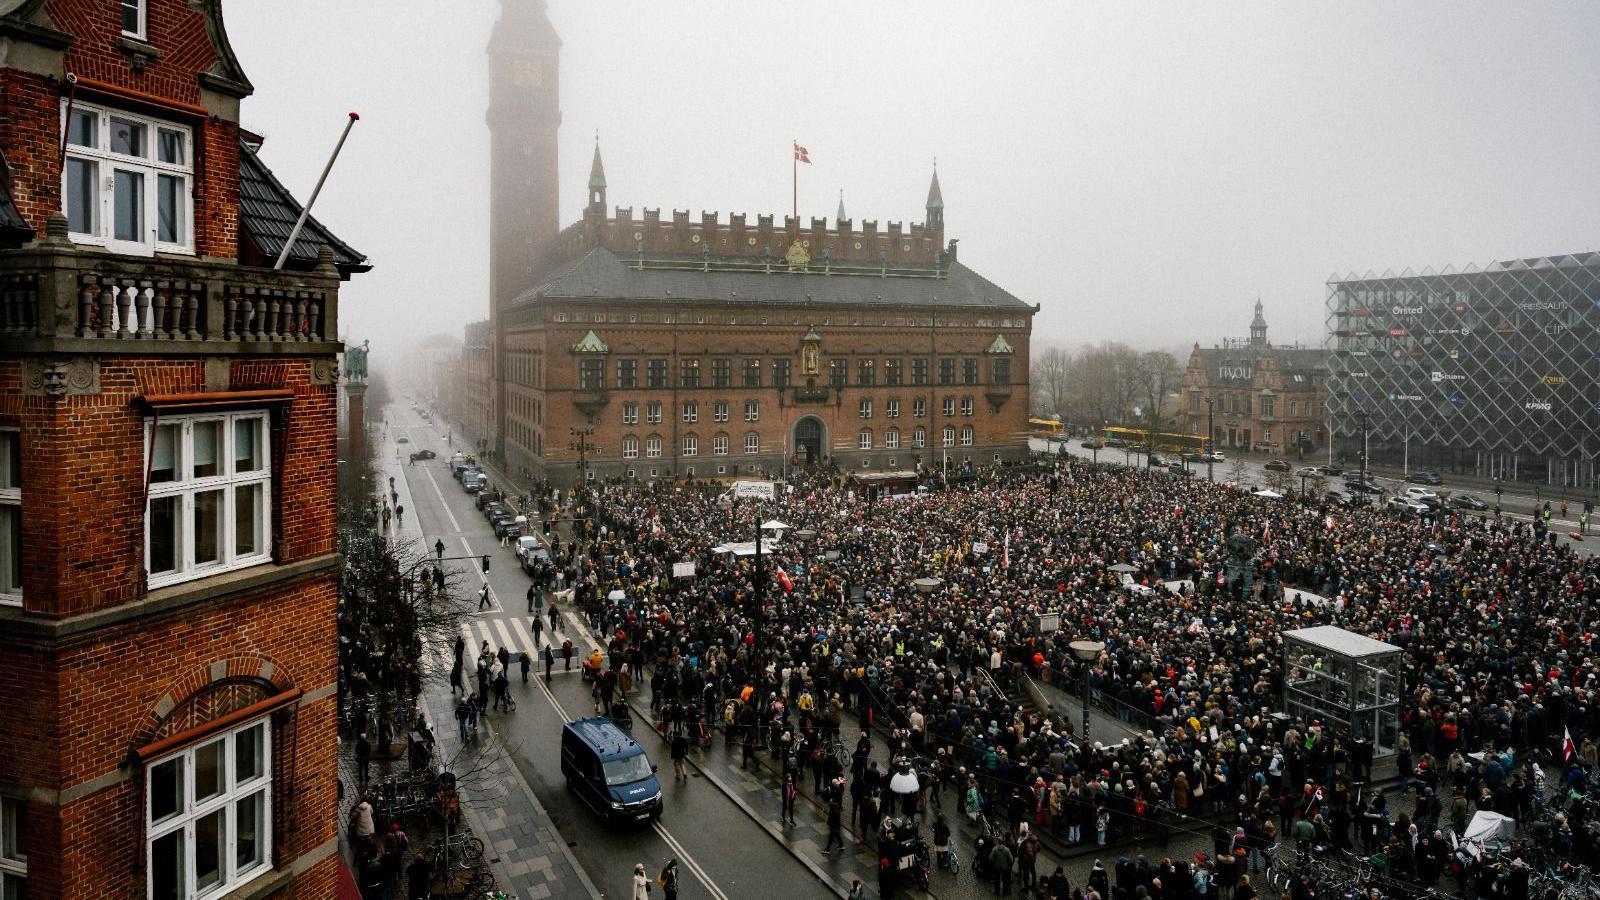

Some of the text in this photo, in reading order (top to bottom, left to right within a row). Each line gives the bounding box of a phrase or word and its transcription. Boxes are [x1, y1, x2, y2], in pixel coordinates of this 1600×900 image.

[1392, 305, 1423, 315] Ørsted
[1218, 366, 1251, 379] TIVOLI
[1525, 402, 1551, 411] KPMG
